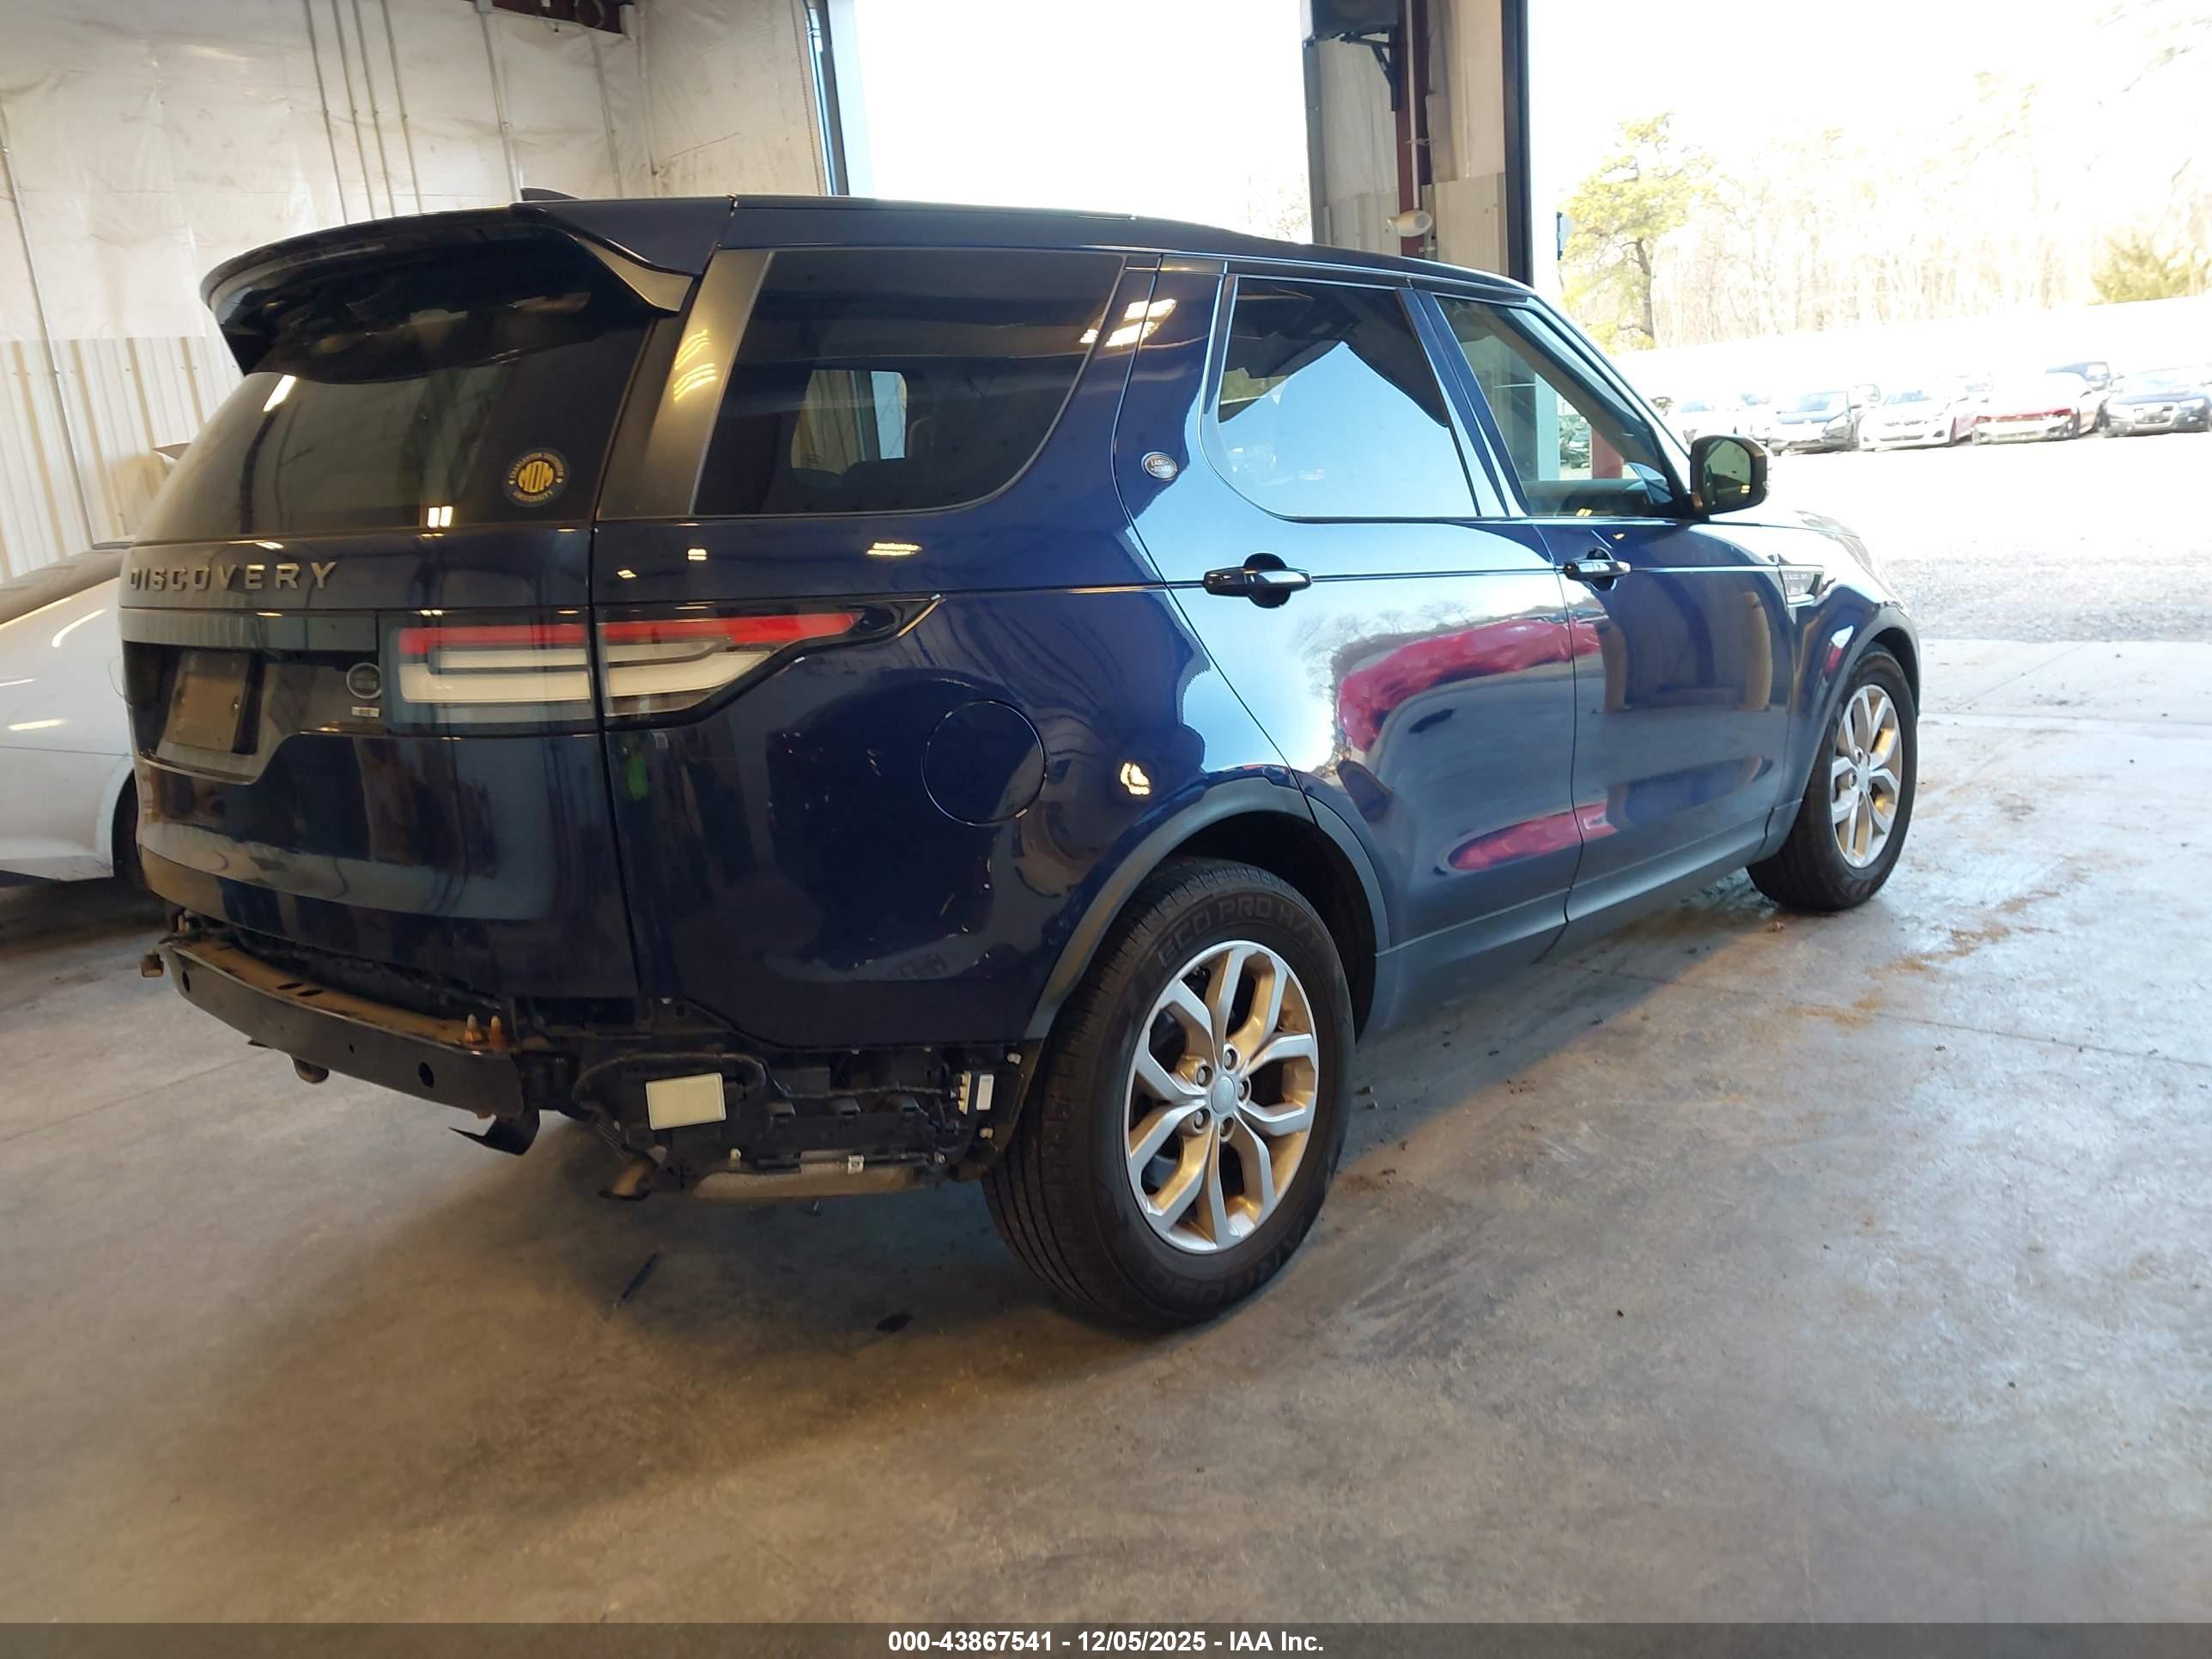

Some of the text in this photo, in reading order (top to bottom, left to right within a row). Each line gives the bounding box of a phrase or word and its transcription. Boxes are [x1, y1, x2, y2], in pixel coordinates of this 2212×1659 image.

[131, 562, 337, 591] DISCOVERY
[1158, 896, 1322, 969] ECO PRO H/T
